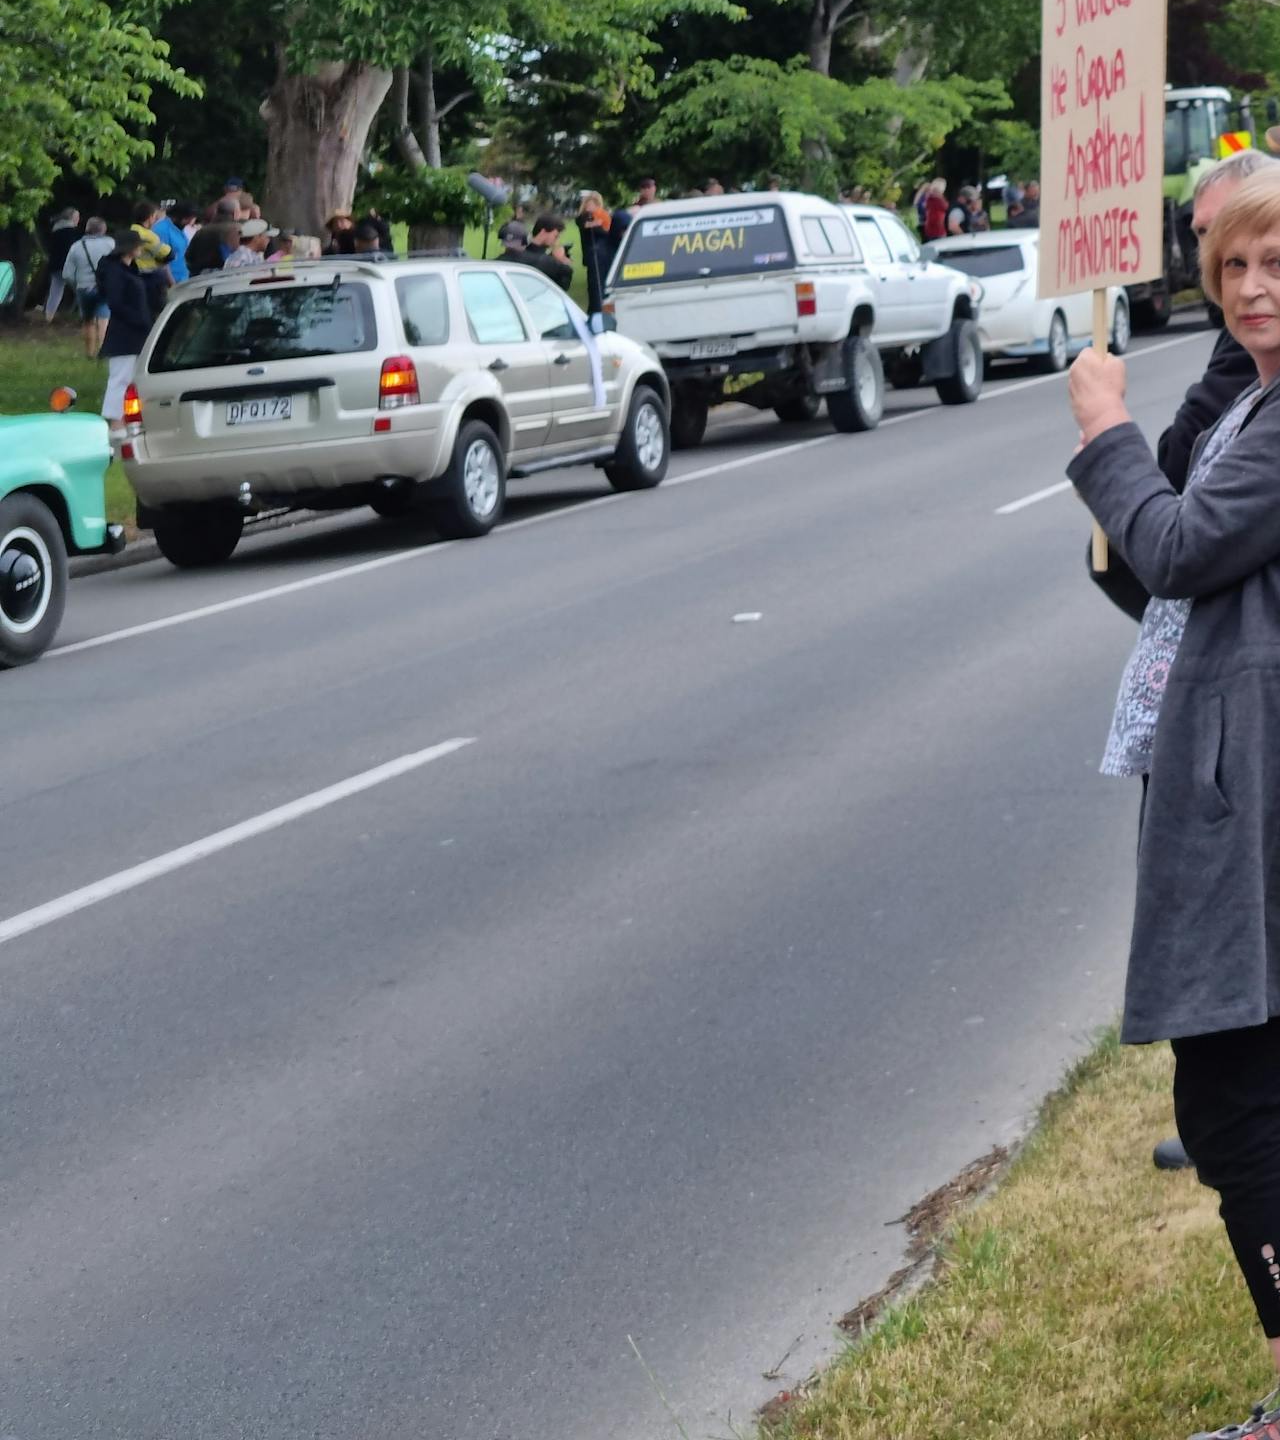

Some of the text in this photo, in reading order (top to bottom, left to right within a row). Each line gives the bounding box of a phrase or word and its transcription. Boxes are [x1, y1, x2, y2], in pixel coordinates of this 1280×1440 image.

[671, 226, 744, 256] MAGA!
[1057, 207, 1142, 290] MANDATES
[229, 398, 290, 420] DFQ172
